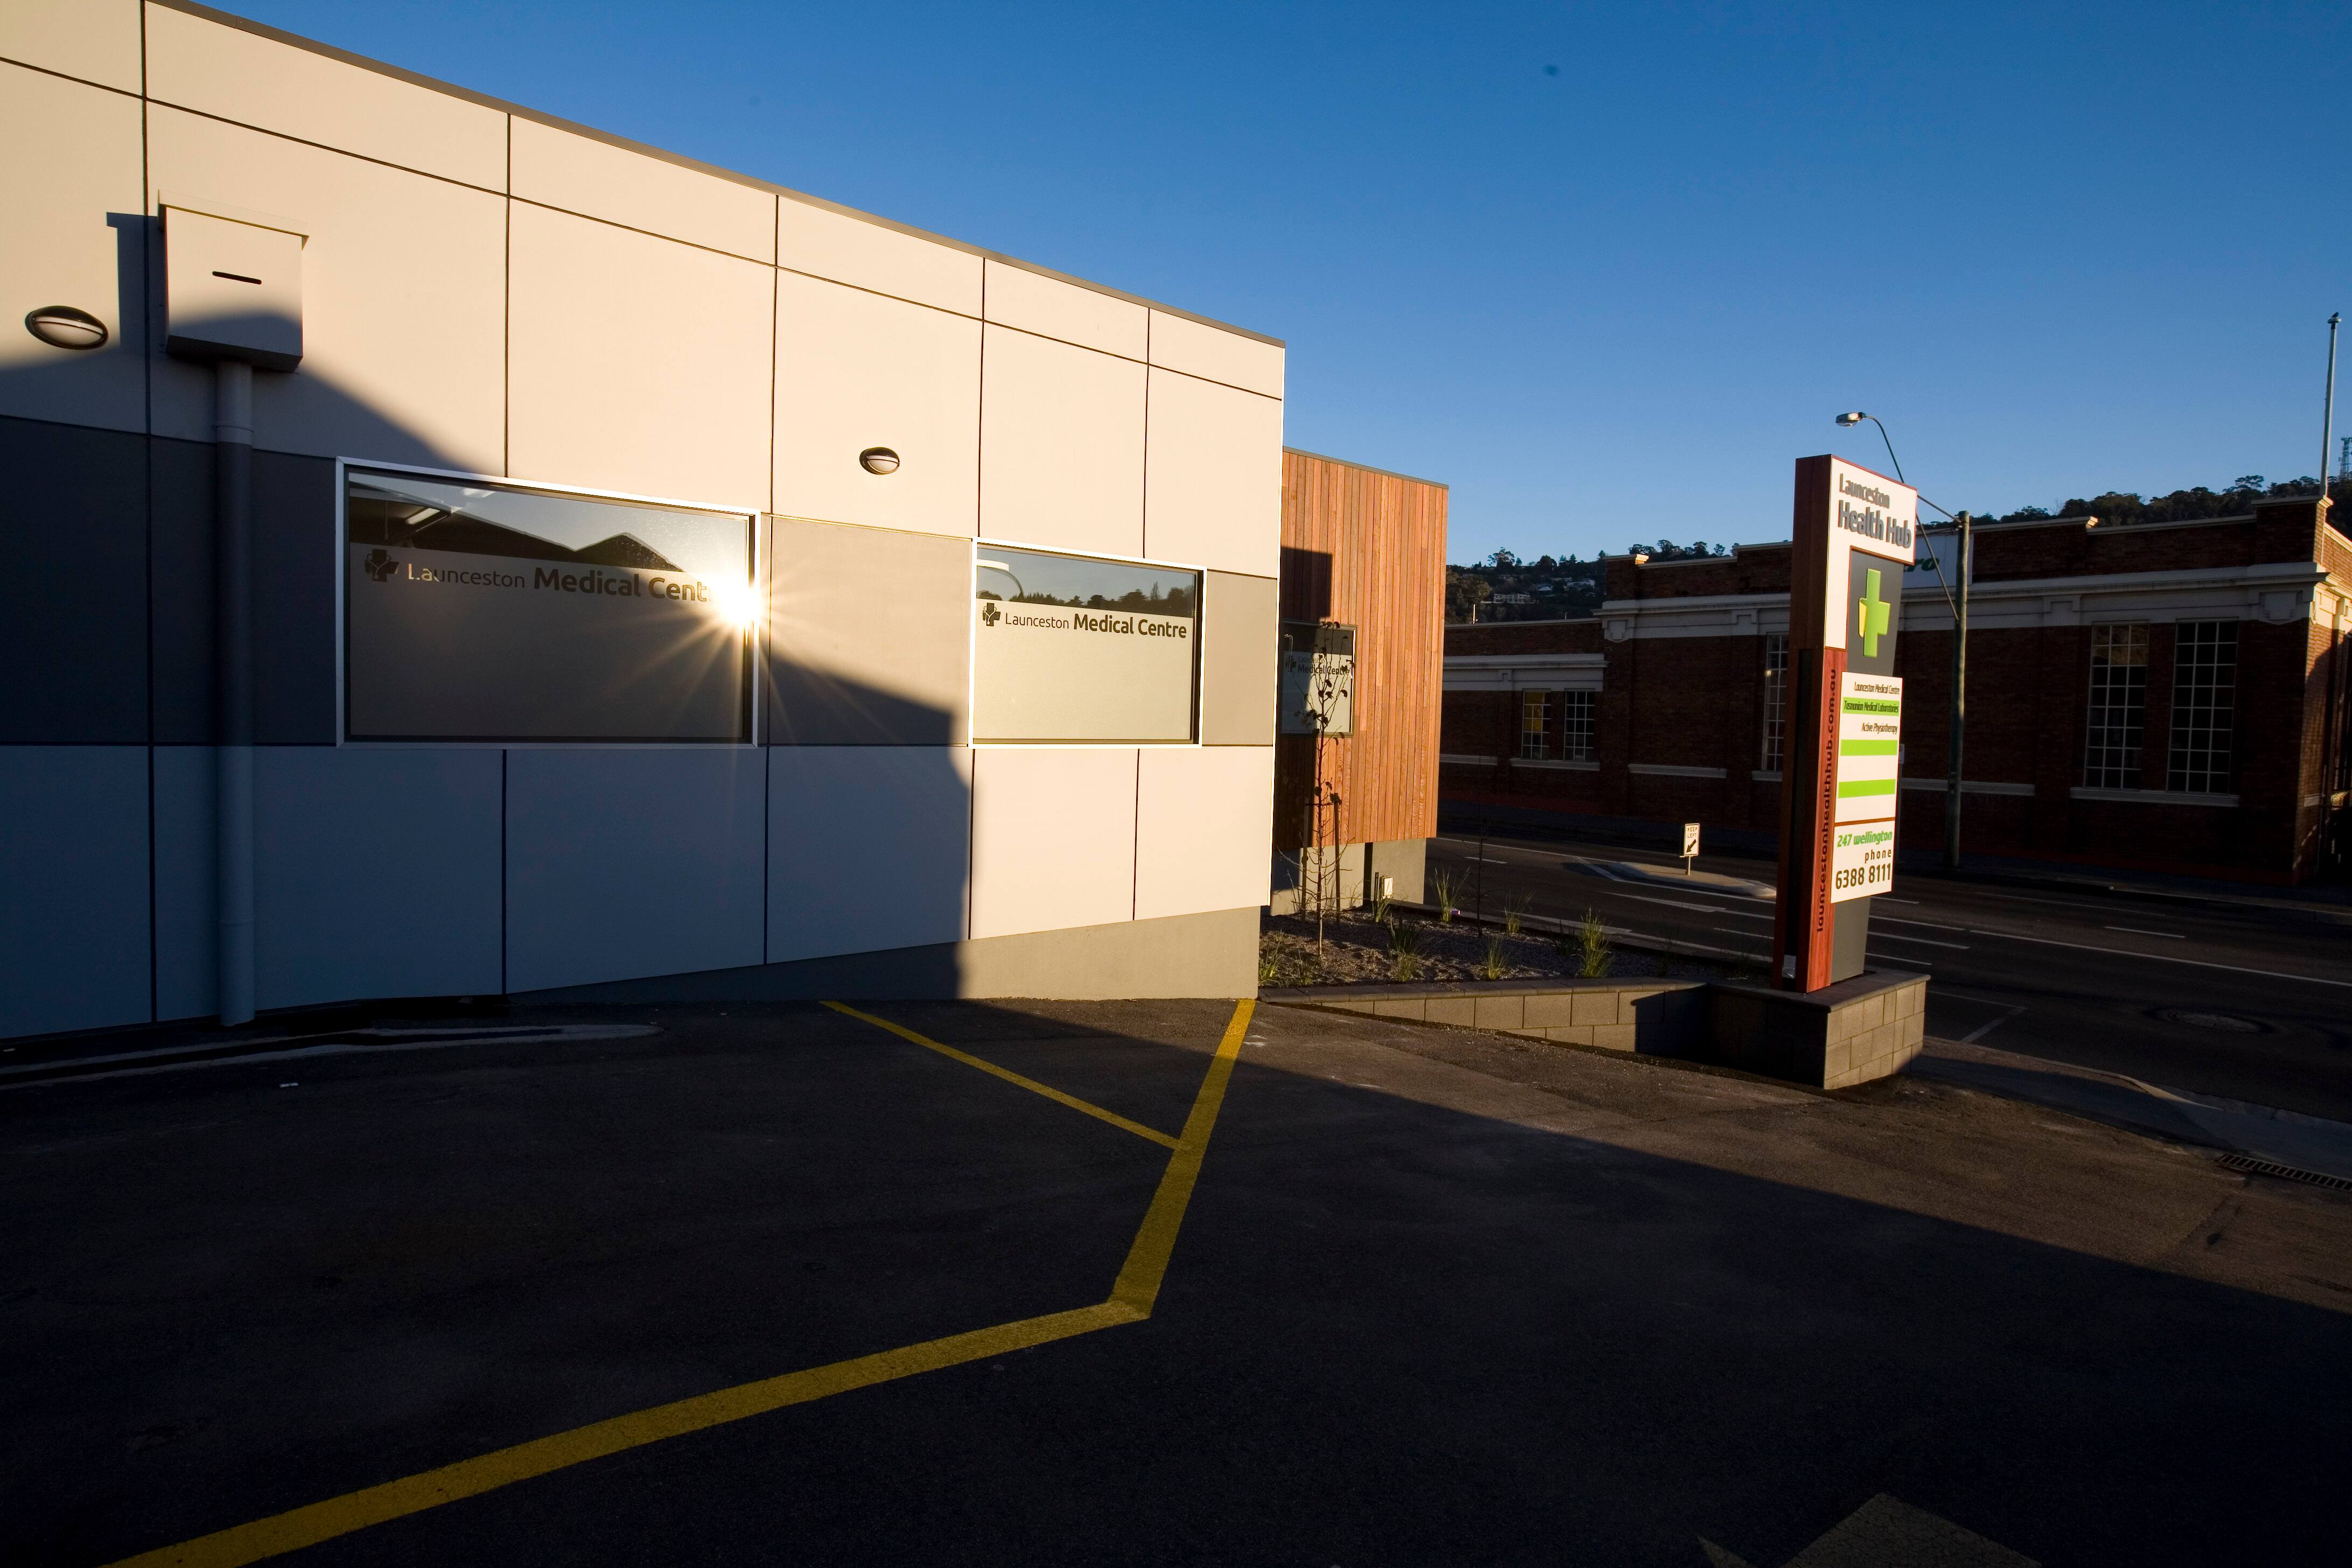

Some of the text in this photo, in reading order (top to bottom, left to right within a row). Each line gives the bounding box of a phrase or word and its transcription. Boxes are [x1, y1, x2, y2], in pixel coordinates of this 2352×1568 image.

[1839, 473, 1890, 509] Launceston
[1838, 500, 1912, 549] Health Hub
[408, 563, 714, 603] Launceston Medical Cent
[1005, 613, 1187, 639] Launceston Medical Centre
[1298, 664, 1325, 674] Medical
[1854, 682, 1900, 695] Launceston Medical Centre
[1844, 701, 1864, 711] Tasmanian
[1864, 702, 1878, 711] Medical
[1861, 722, 1898, 734] Active Physiotherapy
[1817, 669, 1836, 933] launcestonhealthhub.com.au
[1837, 830, 1892, 848] 247 wellington
[1865, 849, 1891, 864] phone
[1836, 863, 1891, 890] 6388 8111
